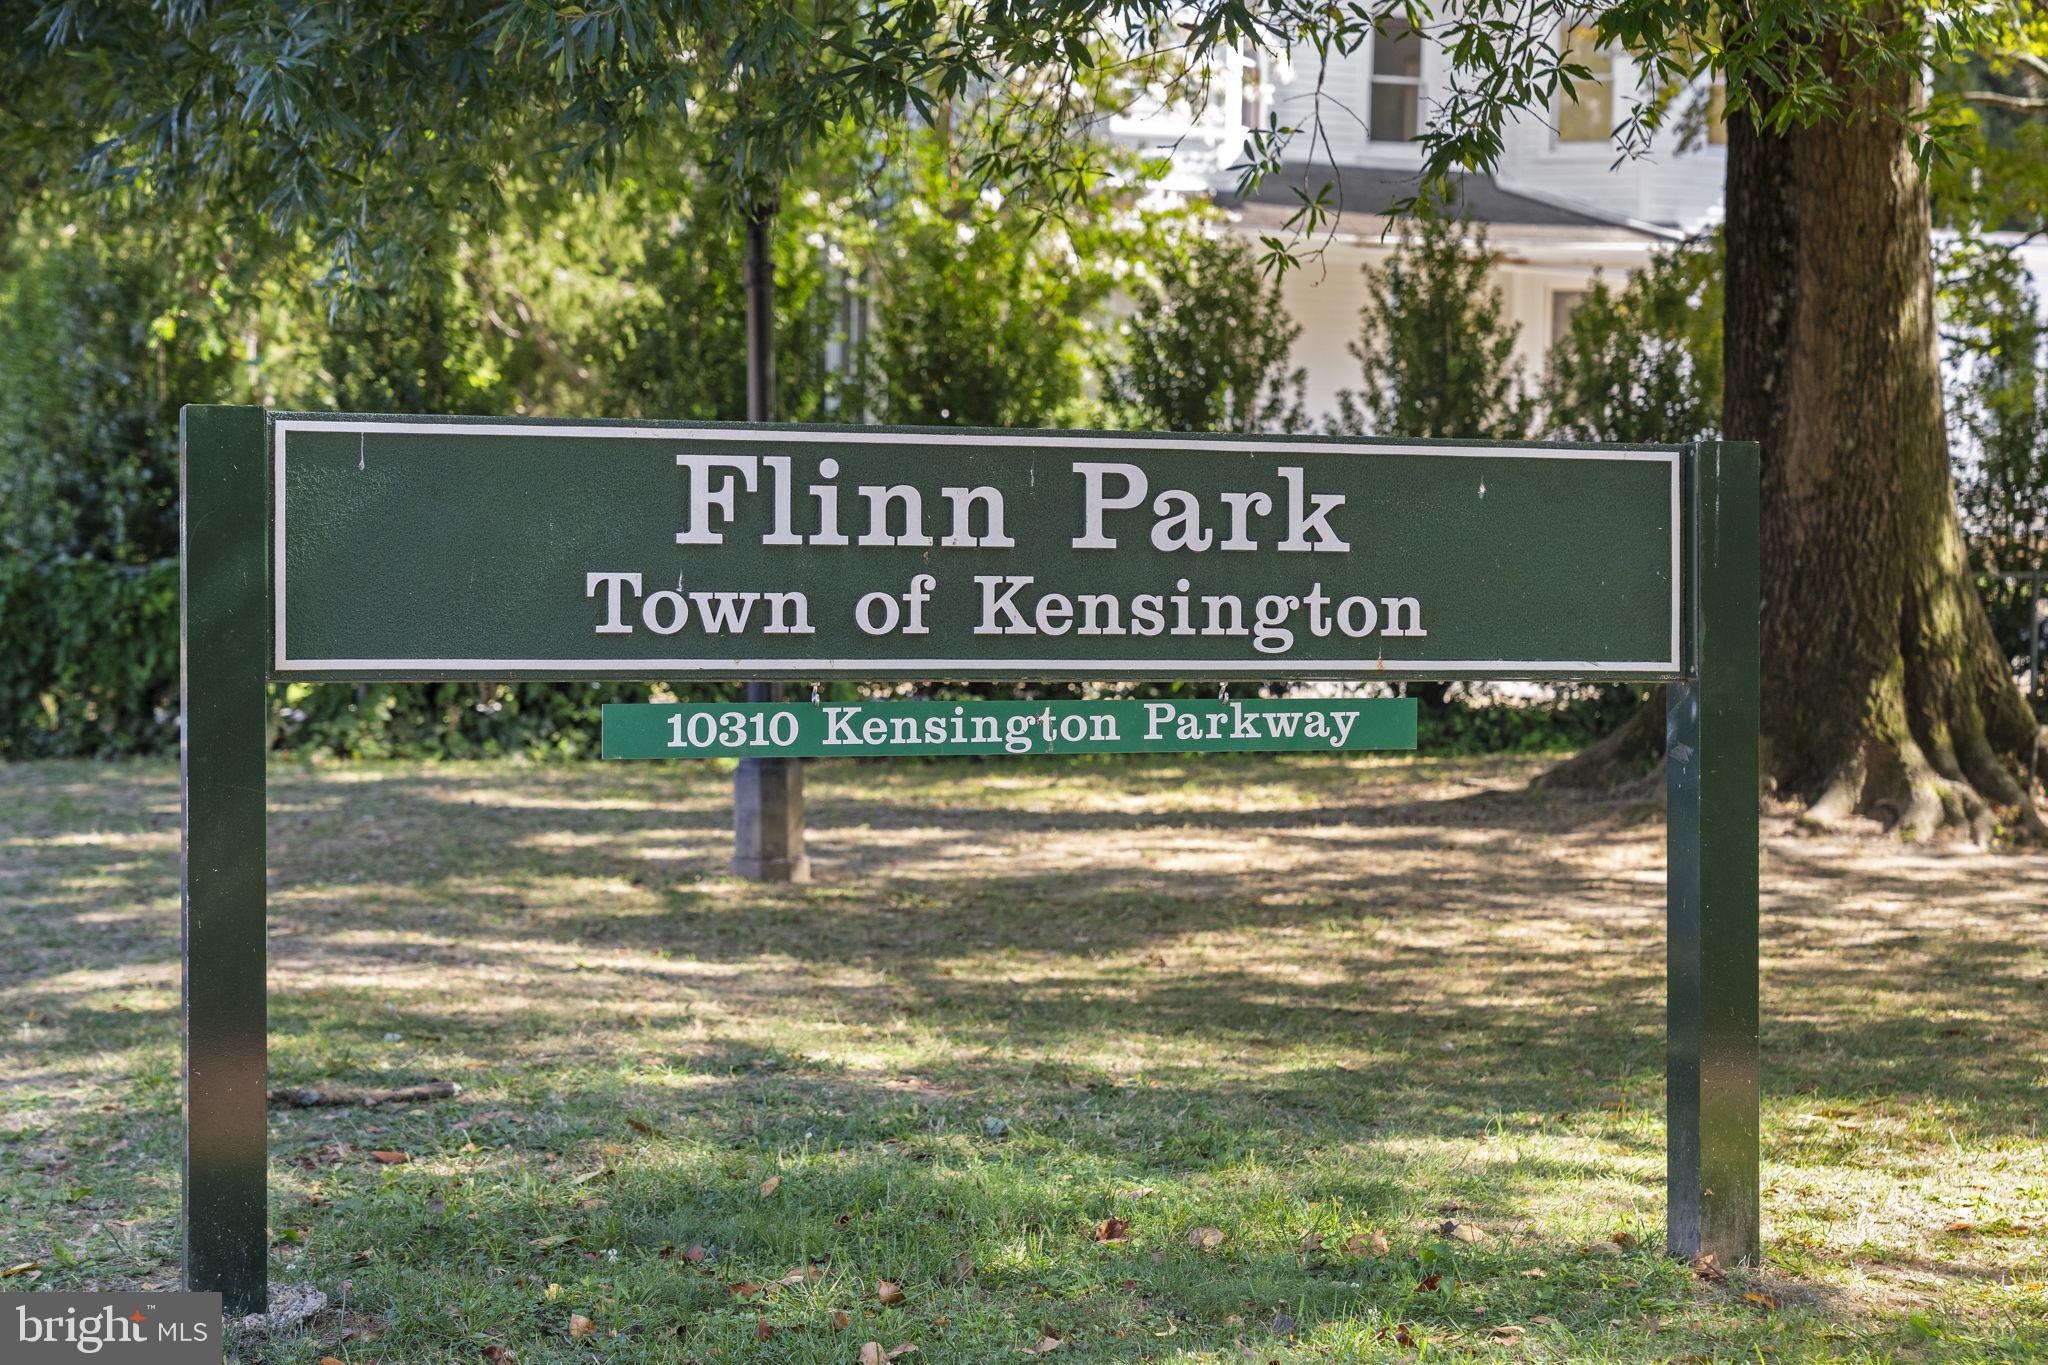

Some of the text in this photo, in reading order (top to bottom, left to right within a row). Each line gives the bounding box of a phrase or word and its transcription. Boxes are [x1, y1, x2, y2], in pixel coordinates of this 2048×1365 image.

[675, 455, 1351, 552] Flinn Park
[586, 572, 1430, 655] Town of Kensington
[667, 702, 1361, 755] 10310 Kensington Parkway
